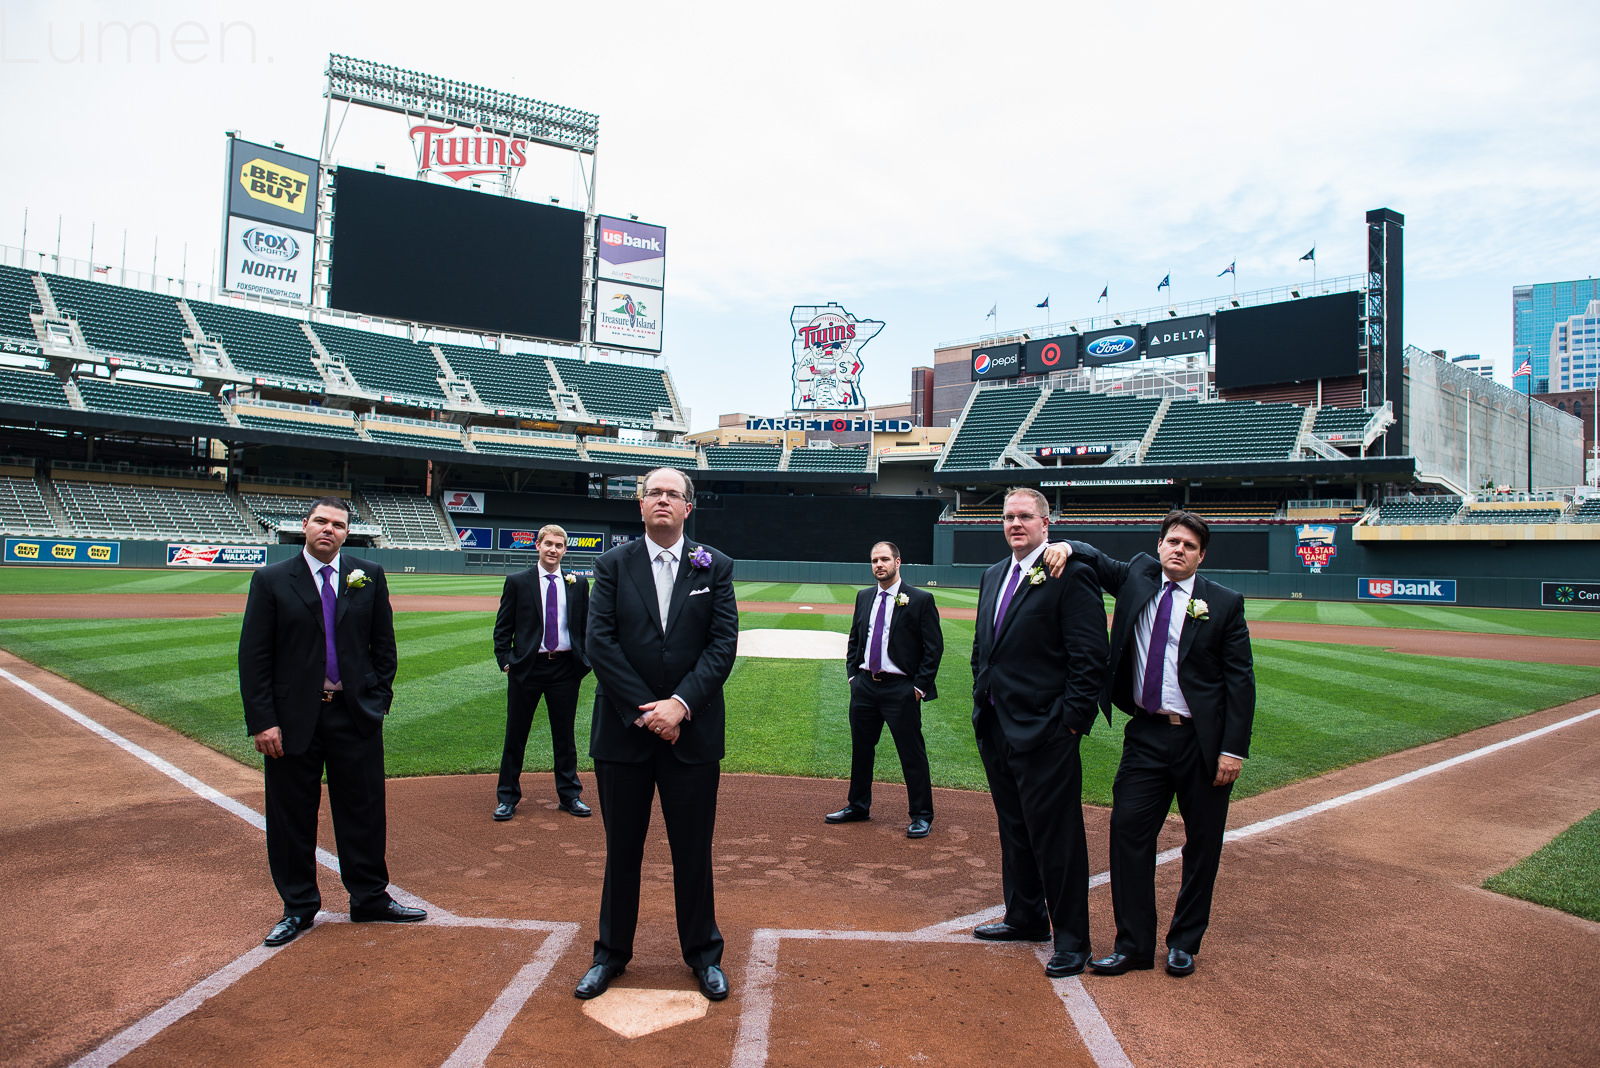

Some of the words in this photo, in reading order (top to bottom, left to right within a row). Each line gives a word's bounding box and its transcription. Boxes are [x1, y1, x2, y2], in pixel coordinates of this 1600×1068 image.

[409, 123, 527, 170] Twins
[250, 164, 307, 193] BEST
[250, 178, 300, 204] BUY
[255, 231, 288, 251] FOX
[254, 245, 288, 258] SPORTS
[241, 259, 298, 283] NORTH
[236, 282, 301, 300] FOXSPORTSNORTH.COM
[601, 312, 629, 326] Treasure
[636, 317, 656, 330] Island
[799, 322, 856, 350] Twins
[1164, 329, 1205, 343] DELTA
[1096, 342, 1125, 354] Ford
[991, 353, 1017, 368] pepsi
[749, 419, 829, 431] TARGET
[852, 420, 912, 432] FIELD
[567, 536, 601, 548] UBWAY
[178, 550, 219, 559] Budweiser
[1578, 590, 1600, 600] Cen
